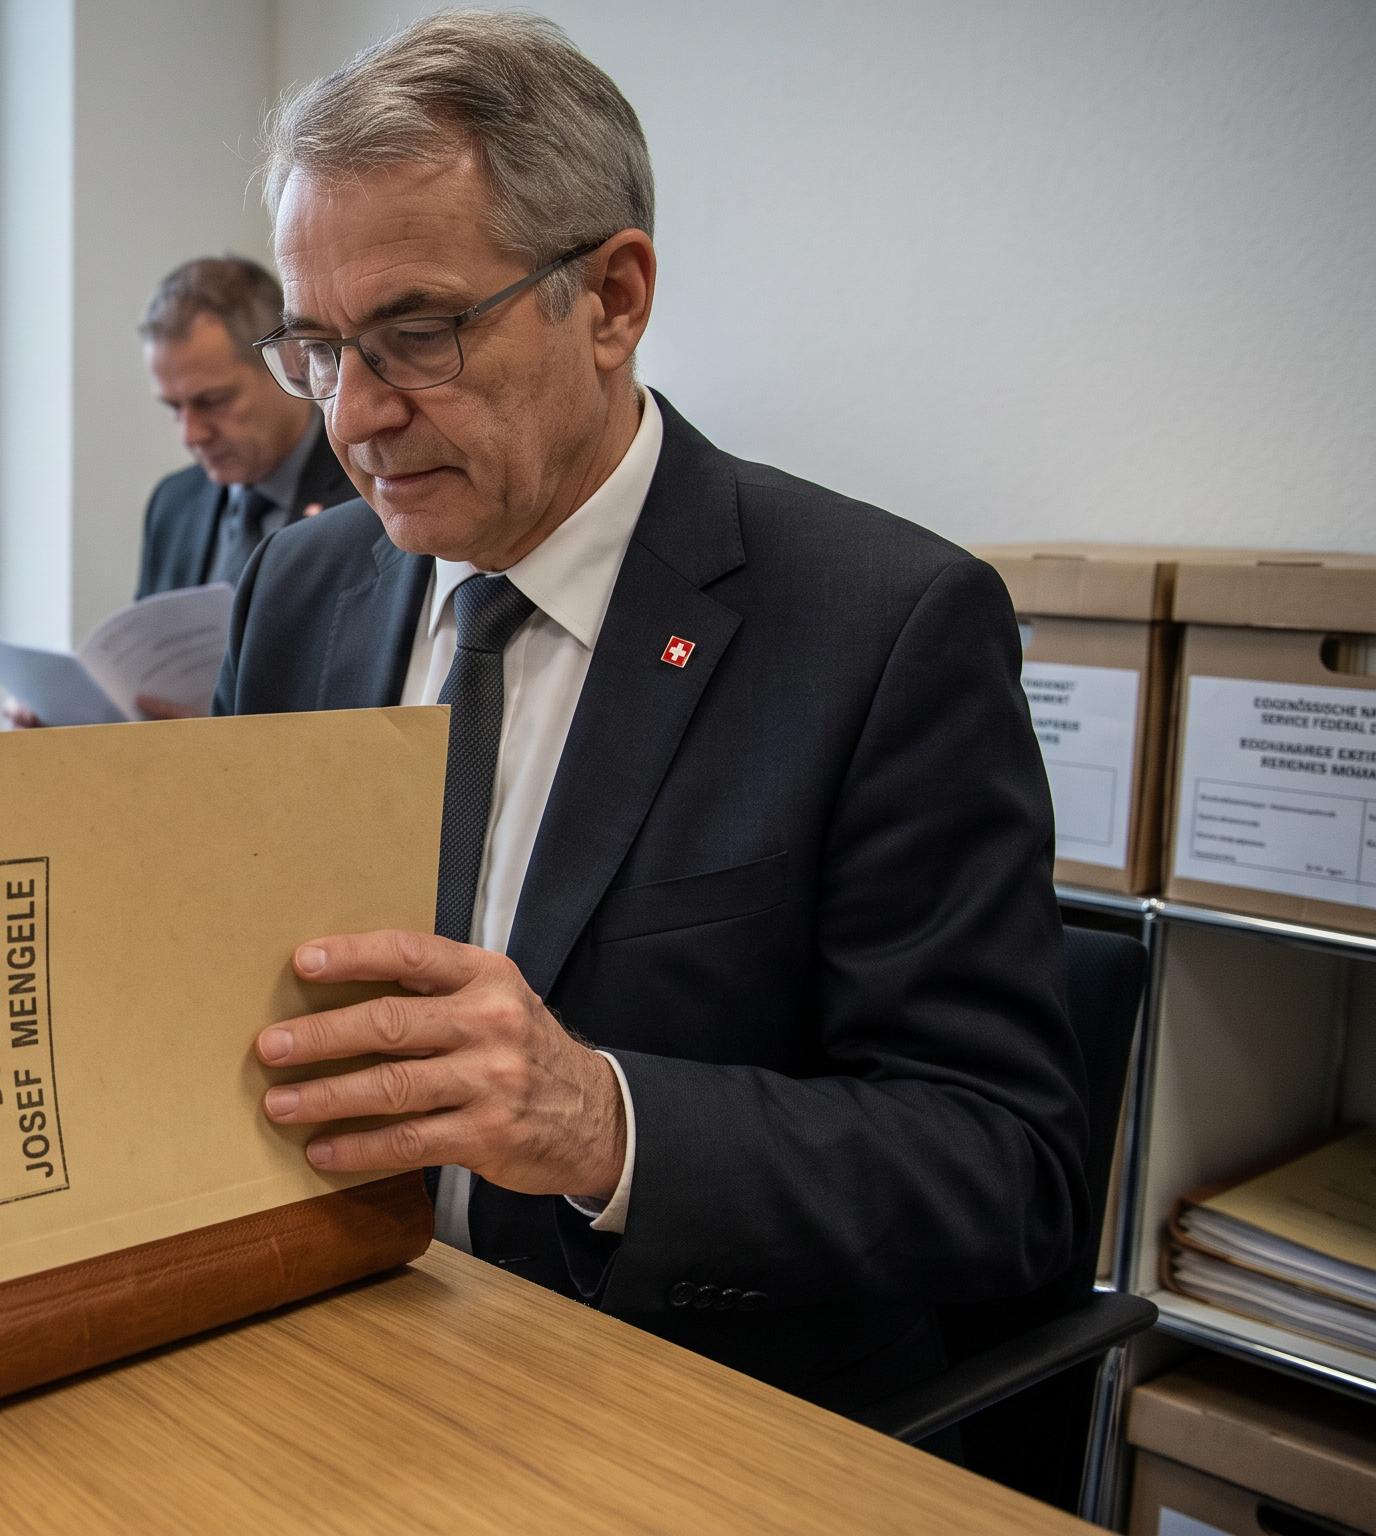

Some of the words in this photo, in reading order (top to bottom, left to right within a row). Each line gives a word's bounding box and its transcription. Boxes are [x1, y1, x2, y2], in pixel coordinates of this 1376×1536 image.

[1261, 711, 1310, 729] SERVICE
[6, 877, 40, 1049] MENGELE
[13, 1068, 54, 1178] JOSEF
